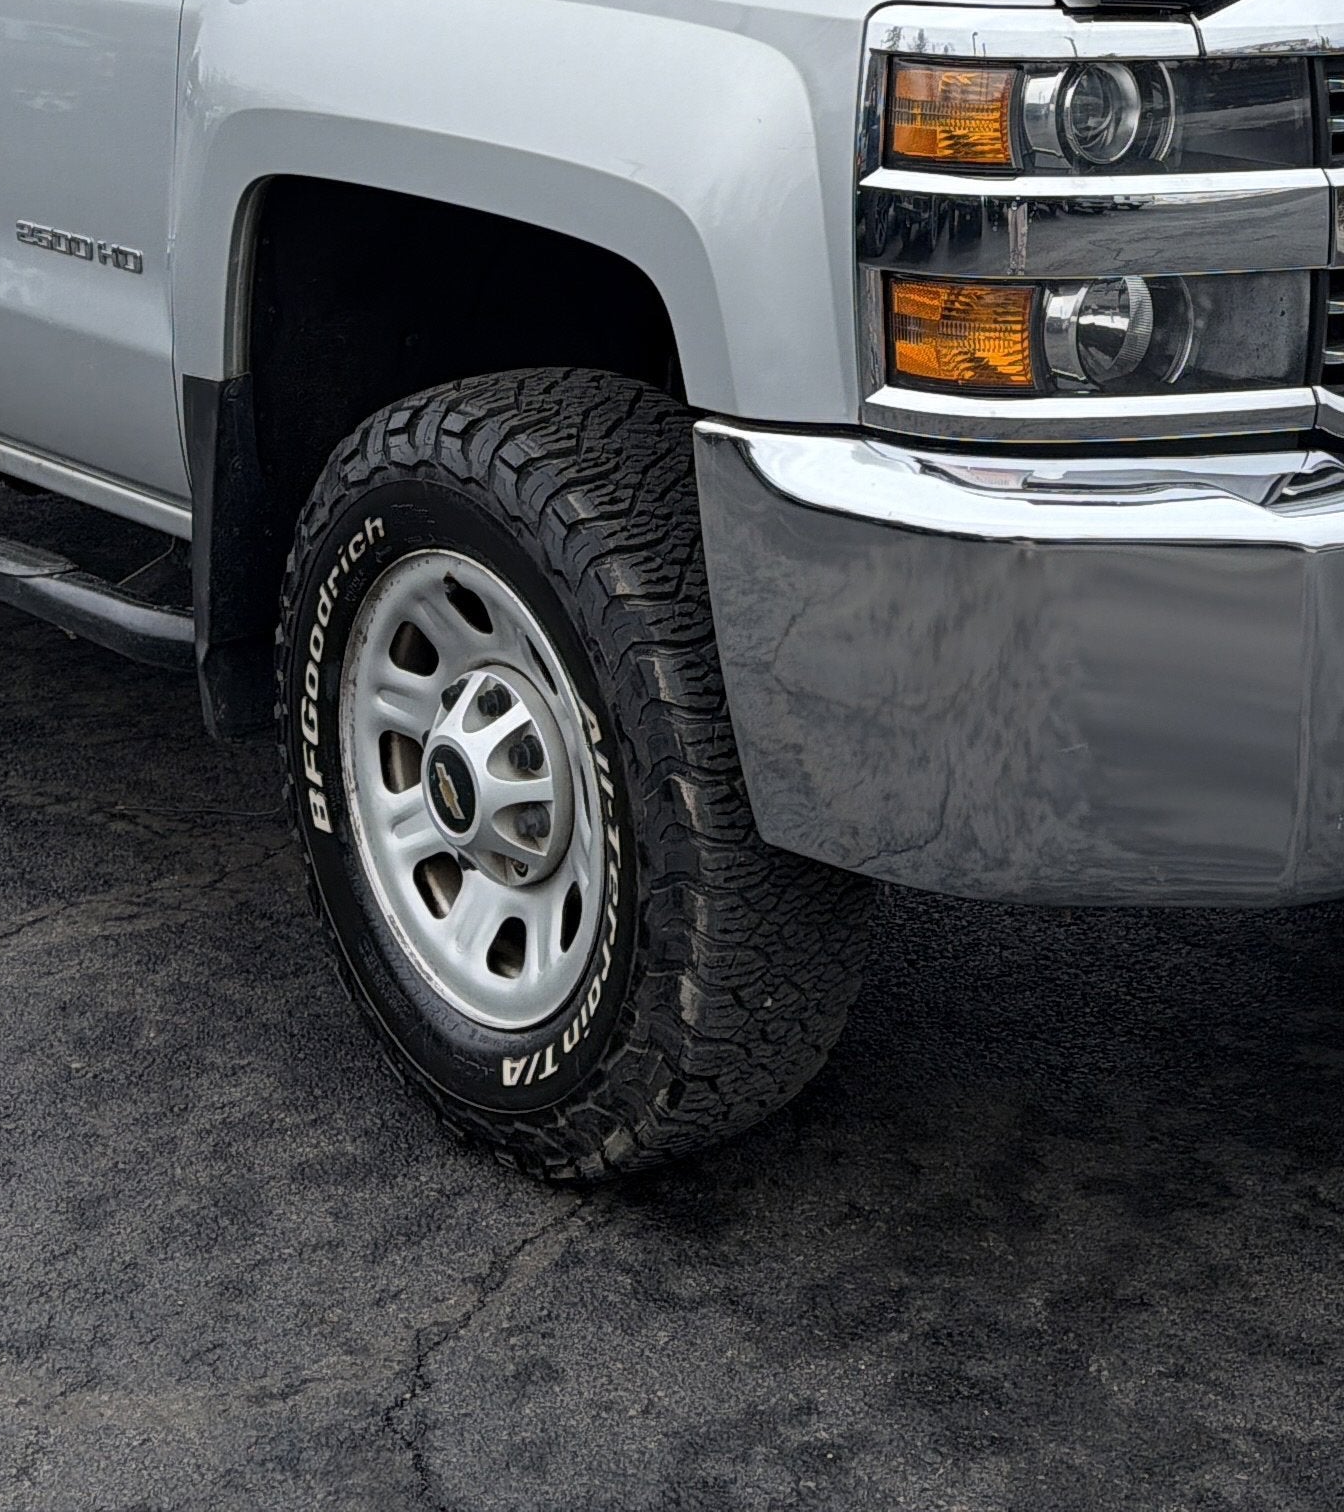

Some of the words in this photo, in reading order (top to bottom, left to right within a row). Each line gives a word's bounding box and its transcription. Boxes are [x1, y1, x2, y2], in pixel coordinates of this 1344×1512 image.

[16, 219, 93, 261] 2500
[97, 240, 143, 274] HD
[301, 516, 385, 834] BFGoodrich
[563, 696, 622, 1054] All-Terrain
[502, 1043, 560, 1087] T/A
